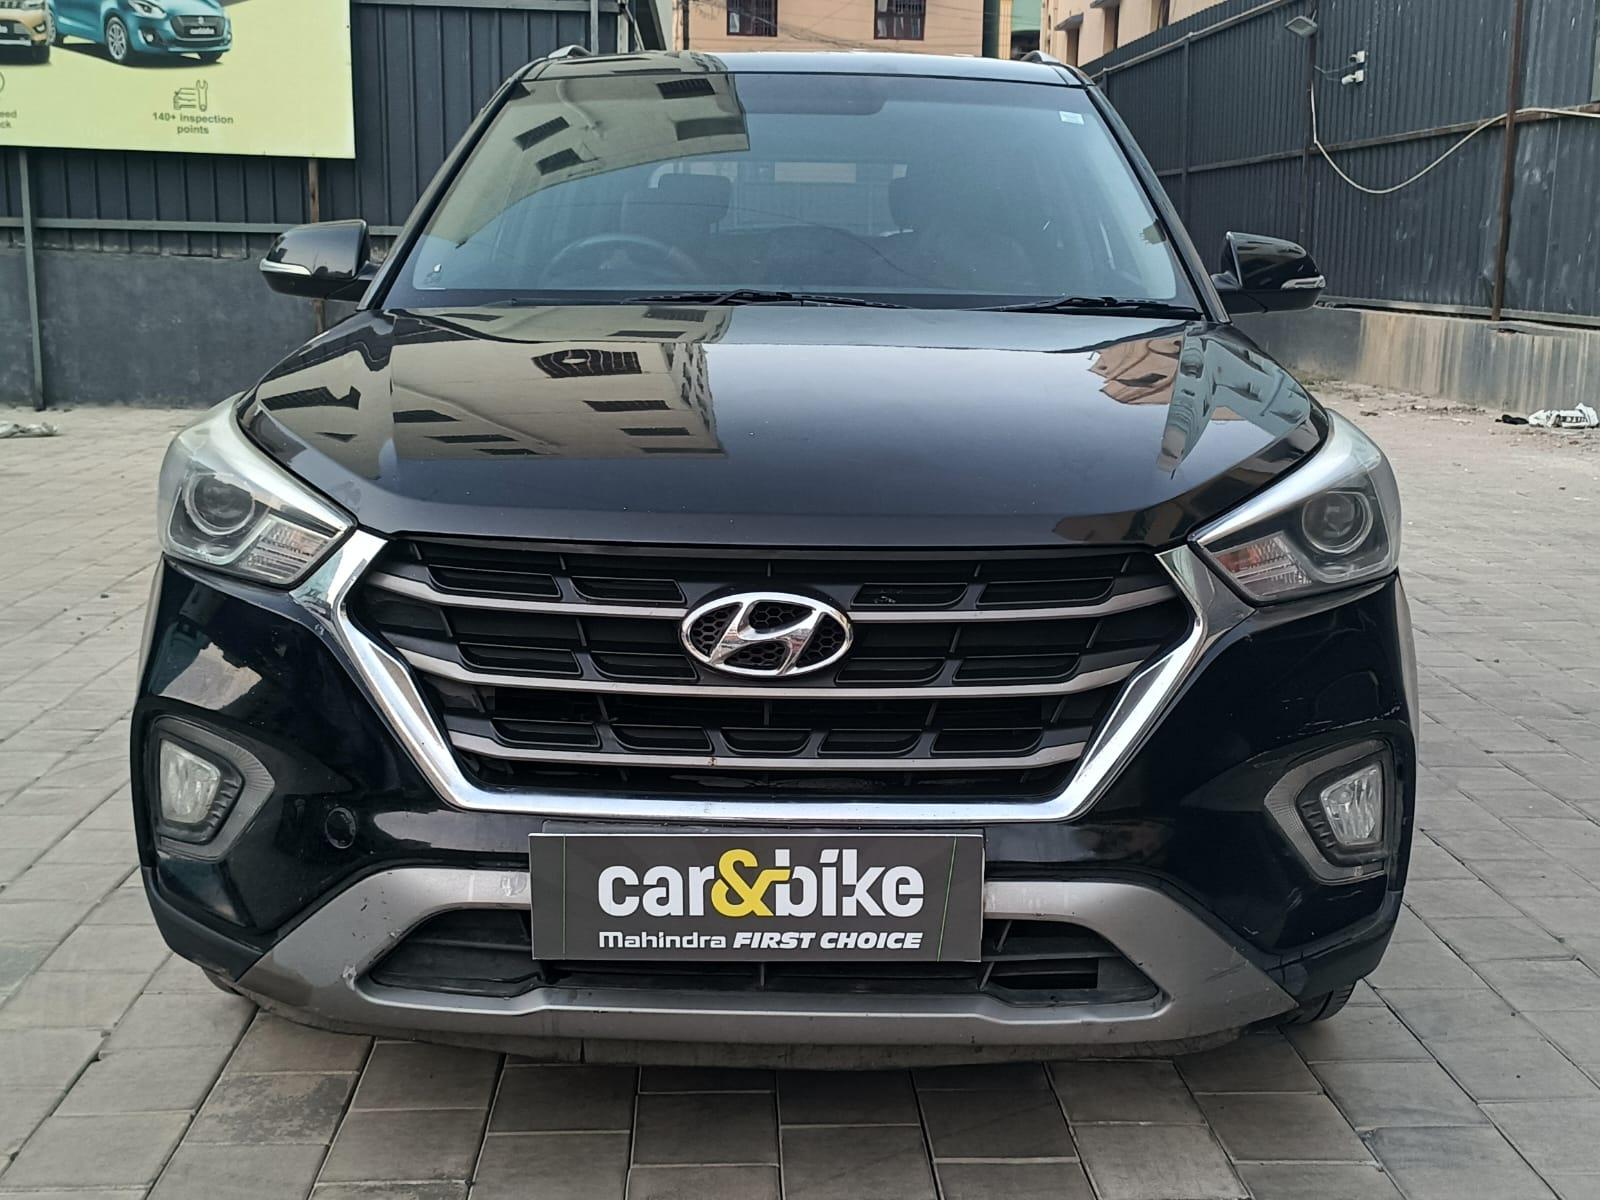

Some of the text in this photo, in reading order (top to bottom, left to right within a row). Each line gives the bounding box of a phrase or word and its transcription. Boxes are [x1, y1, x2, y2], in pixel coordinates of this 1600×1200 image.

[153, 112, 176, 121] 140+
[177, 125, 210, 135] points
[598, 848, 924, 917] car&bike
[599, 931, 924, 949] Mahindra FIRST CHOICE
